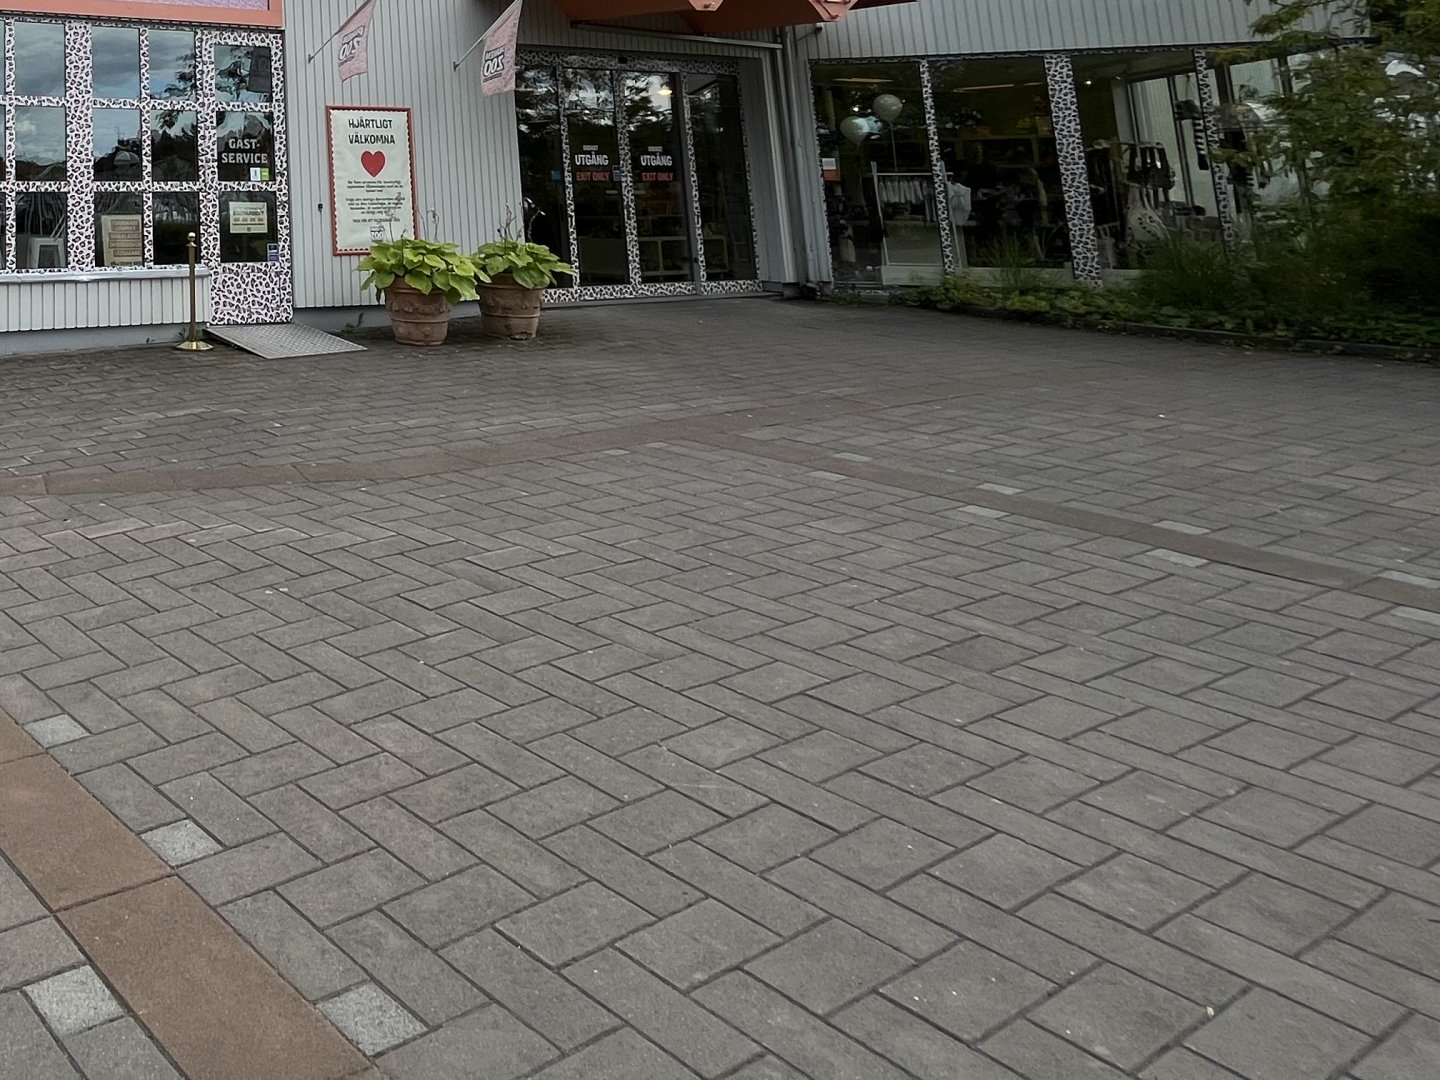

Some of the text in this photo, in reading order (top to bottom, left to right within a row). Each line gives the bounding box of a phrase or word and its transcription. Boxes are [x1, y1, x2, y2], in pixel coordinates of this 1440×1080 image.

[348, 116, 393, 129] HJÄRTLIGT
[348, 132, 395, 145] VÄLKOMNA
[221, 152, 268, 164] SERVICE
[574, 151, 609, 166] UTGÅNG
[640, 152, 672, 166] UTGÅNG
